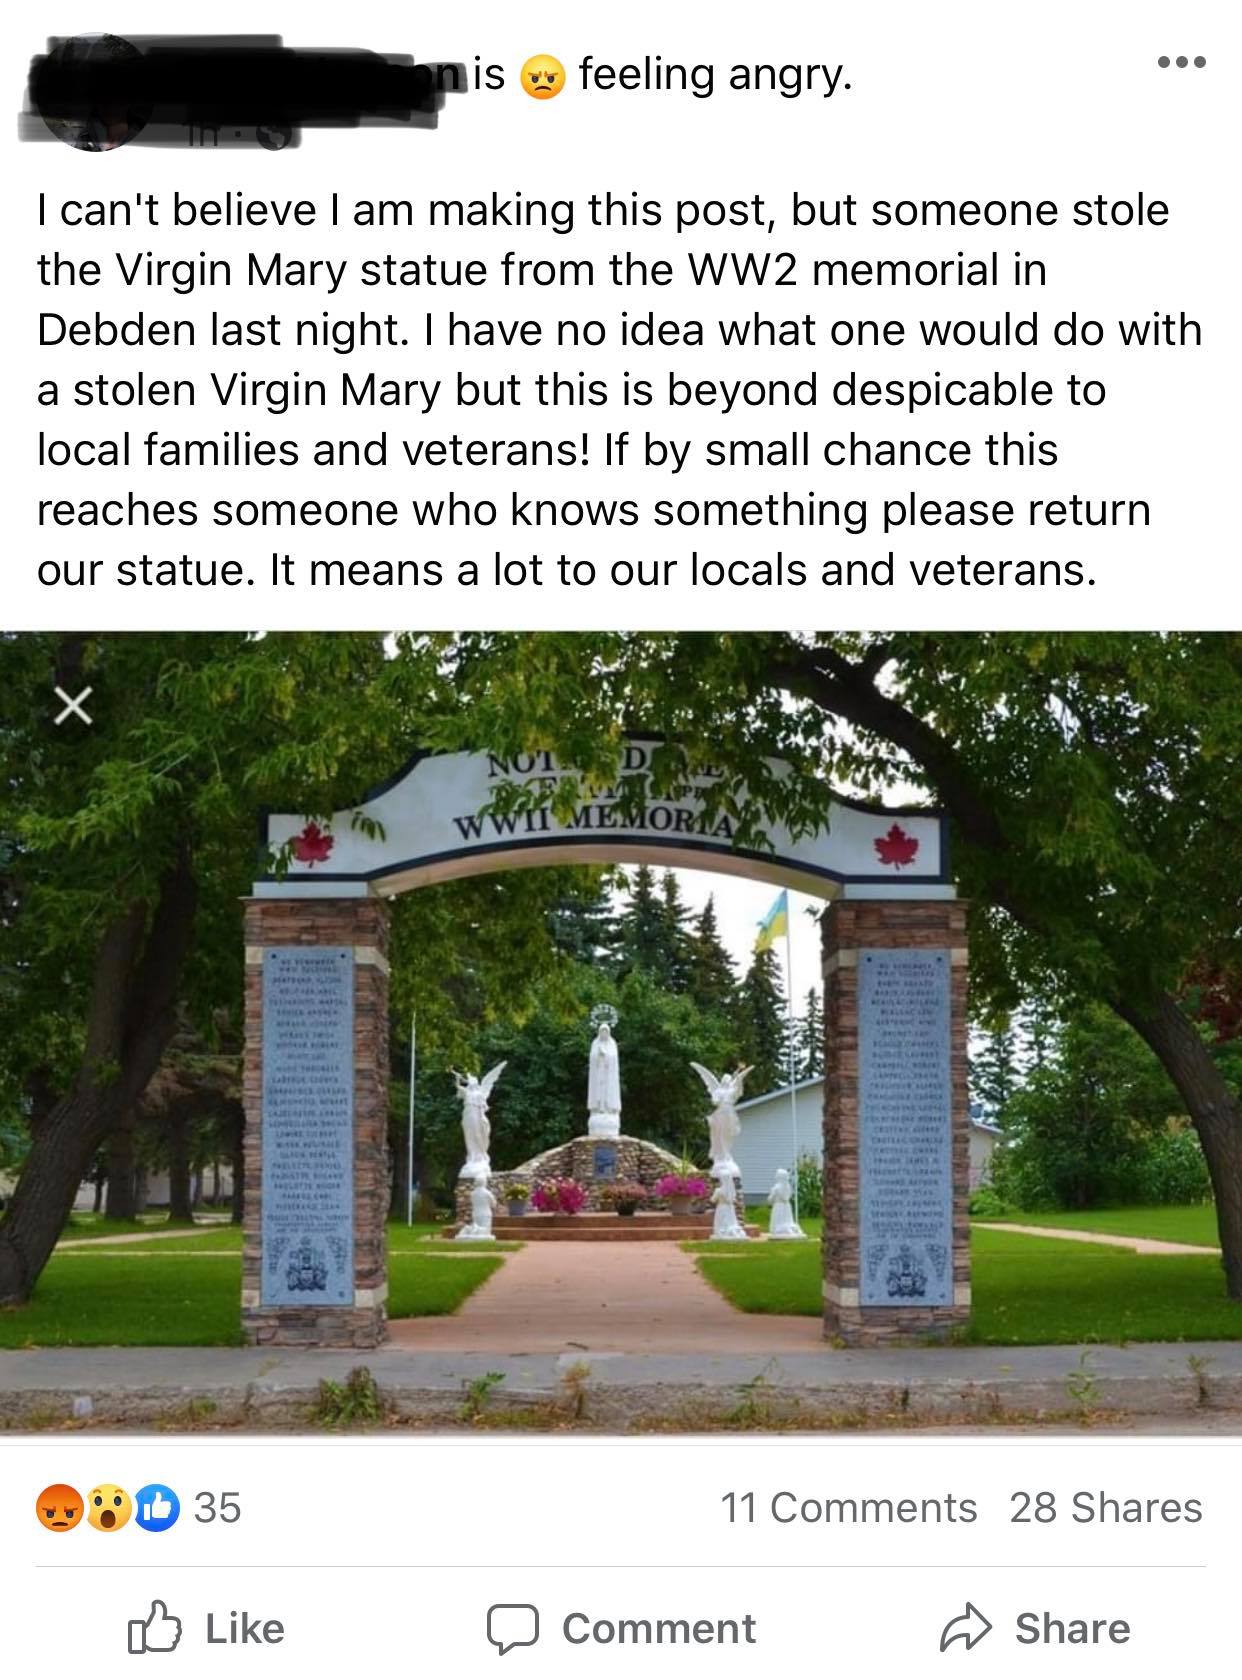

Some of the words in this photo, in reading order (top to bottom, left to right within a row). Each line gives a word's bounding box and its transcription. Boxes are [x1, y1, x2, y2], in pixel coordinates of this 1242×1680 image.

[474, 54, 505, 91] is
[578, 54, 714, 99] feeling
[729, 64, 852, 99] angry.
[38, 192, 46, 226] I
[60, 192, 160, 227] can't
[173, 190, 317, 227] believe
[331, 192, 339, 226] I
[353, 200, 413, 227] am
[429, 190, 574, 235] making
[587, 190, 662, 227] this
[676, 194, 775, 234] post,
[792, 191, 857, 227] but
[871, 200, 1059, 227] someone
[1072, 191, 1170, 227] stole
[36, 251, 102, 287] the
[115, 250, 231, 295] Virgin
[248, 252, 348, 295] Mary
[360, 254, 488, 287] statue
[500, 251, 594, 287] from
[608, 251, 674, 287] the
[687, 251, 797, 286] WW2
[813, 250, 998, 287] memorial
[1014, 250, 1046, 286] in
[39, 311, 195, 347] Debden
[211, 311, 281, 347] last
[296, 310, 409, 355] night.
[425, 312, 433, 346] I
[448, 311, 543, 347] have
[557, 320, 606, 347] no
[621, 310, 704, 347] idea
[718, 311, 816, 347] what
[830, 320, 906, 347] one
[919, 311, 1038, 347] would
[1053, 311, 1104, 347] do
[1118, 310, 1202, 346] with
[37, 380, 59, 407] a
[73, 371, 195, 407] stolen
[209, 370, 326, 415] Virgin
[342, 372, 442, 415] Mary
[456, 371, 521, 407] but
[534, 370, 608, 407] this
[623, 370, 653, 407] is
[668, 371, 817, 415] beyond
[832, 370, 1054, 414] despicable
[1066, 374, 1106, 407] to
[39, 431, 130, 467] local
[143, 430, 299, 467] families
[313, 431, 387, 467] and
[402, 432, 589, 467] veterans!
[606, 430, 630, 466] If
[644, 431, 692, 475] by
[705, 431, 809, 467] small
[823, 431, 972, 467] chance
[984, 430, 1058, 467] this
[38, 491, 198, 527] reaches
[212, 500, 399, 527] someone
[411, 491, 497, 527] who
[511, 491, 639, 527] knows
[653, 490, 867, 535] something
[883, 491, 1015, 534] please
[1029, 494, 1150, 527] return
[37, 560, 104, 587] our
[116, 554, 255, 587] statue.
[272, 552, 296, 586] It
[310, 560, 443, 587] means
[457, 560, 479, 587] a
[495, 551, 544, 587] lot
[556, 554, 596, 587] to
[610, 560, 678, 587] our
[691, 551, 807, 587] locals
[821, 551, 894, 587] and
[909, 554, 1096, 587] veterans.
[453, 805, 551, 841] WWII
[562, 804, 738, 839] MEMORIA
[194, 1491, 241, 1524] 35
[721, 1491, 754, 1523] 11
[771, 1491, 978, 1524] Comments
[1010, 1491, 1057, 1524] 28
[1071, 1490, 1203, 1524] Shares
[207, 1610, 285, 1645] Like
[562, 1612, 757, 1645] Comment
[1015, 1611, 1131, 1645] Share
